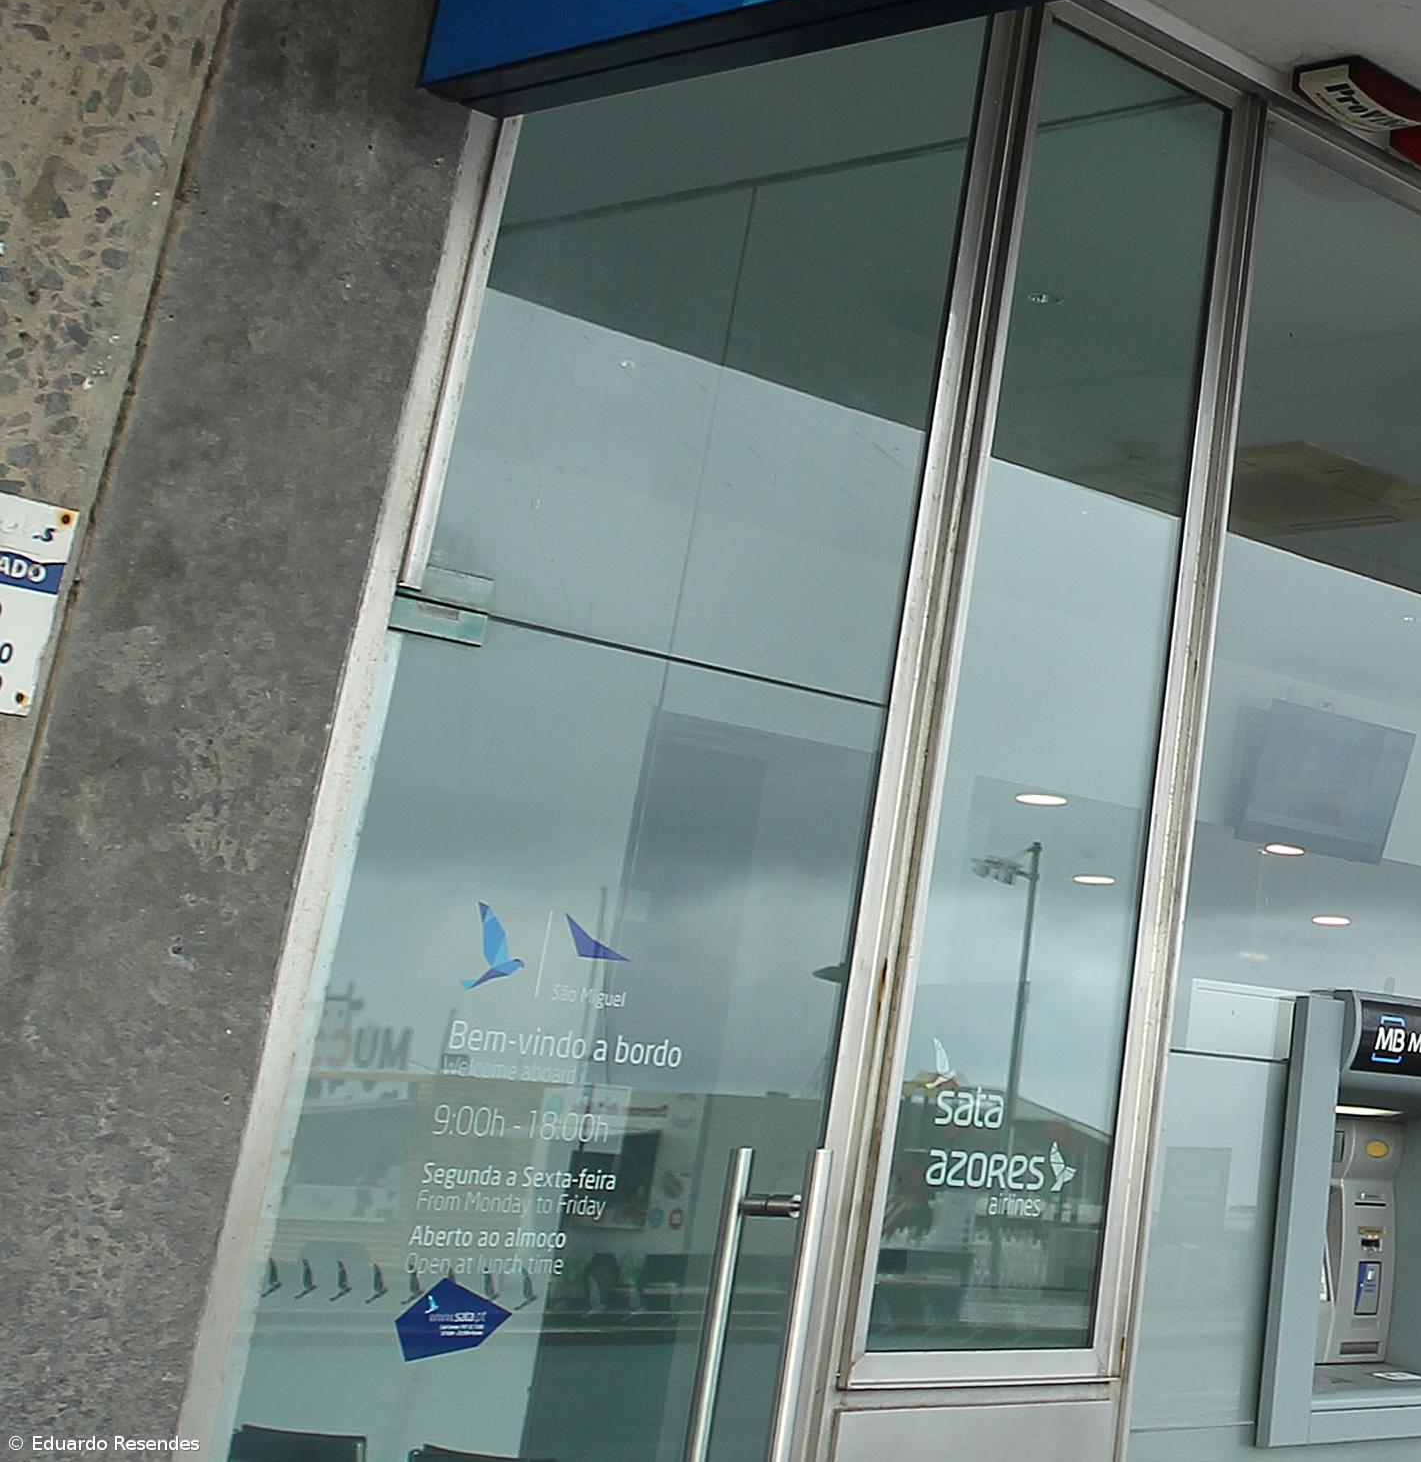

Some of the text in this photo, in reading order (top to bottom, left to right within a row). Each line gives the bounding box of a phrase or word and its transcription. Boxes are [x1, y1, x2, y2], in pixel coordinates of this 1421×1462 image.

[551, 984, 627, 1009] São Miguel
[449, 1020, 682, 1069] Bem-vindo a bordo
[1374, 1026, 1405, 1053] MB
[934, 1086, 1004, 1129] sata
[432, 1105, 505, 1137] 9:00h
[529, 1110, 608, 1143] 18:00h
[422, 1162, 617, 1190] Segunda a Sexta-feira
[416, 1190, 606, 1220] From Monday to Friday
[988, 1193, 1042, 1217] airlines
[409, 1225, 566, 1253] Aberto ao almoço
[405, 1253, 564, 1277] Open at lunch time
